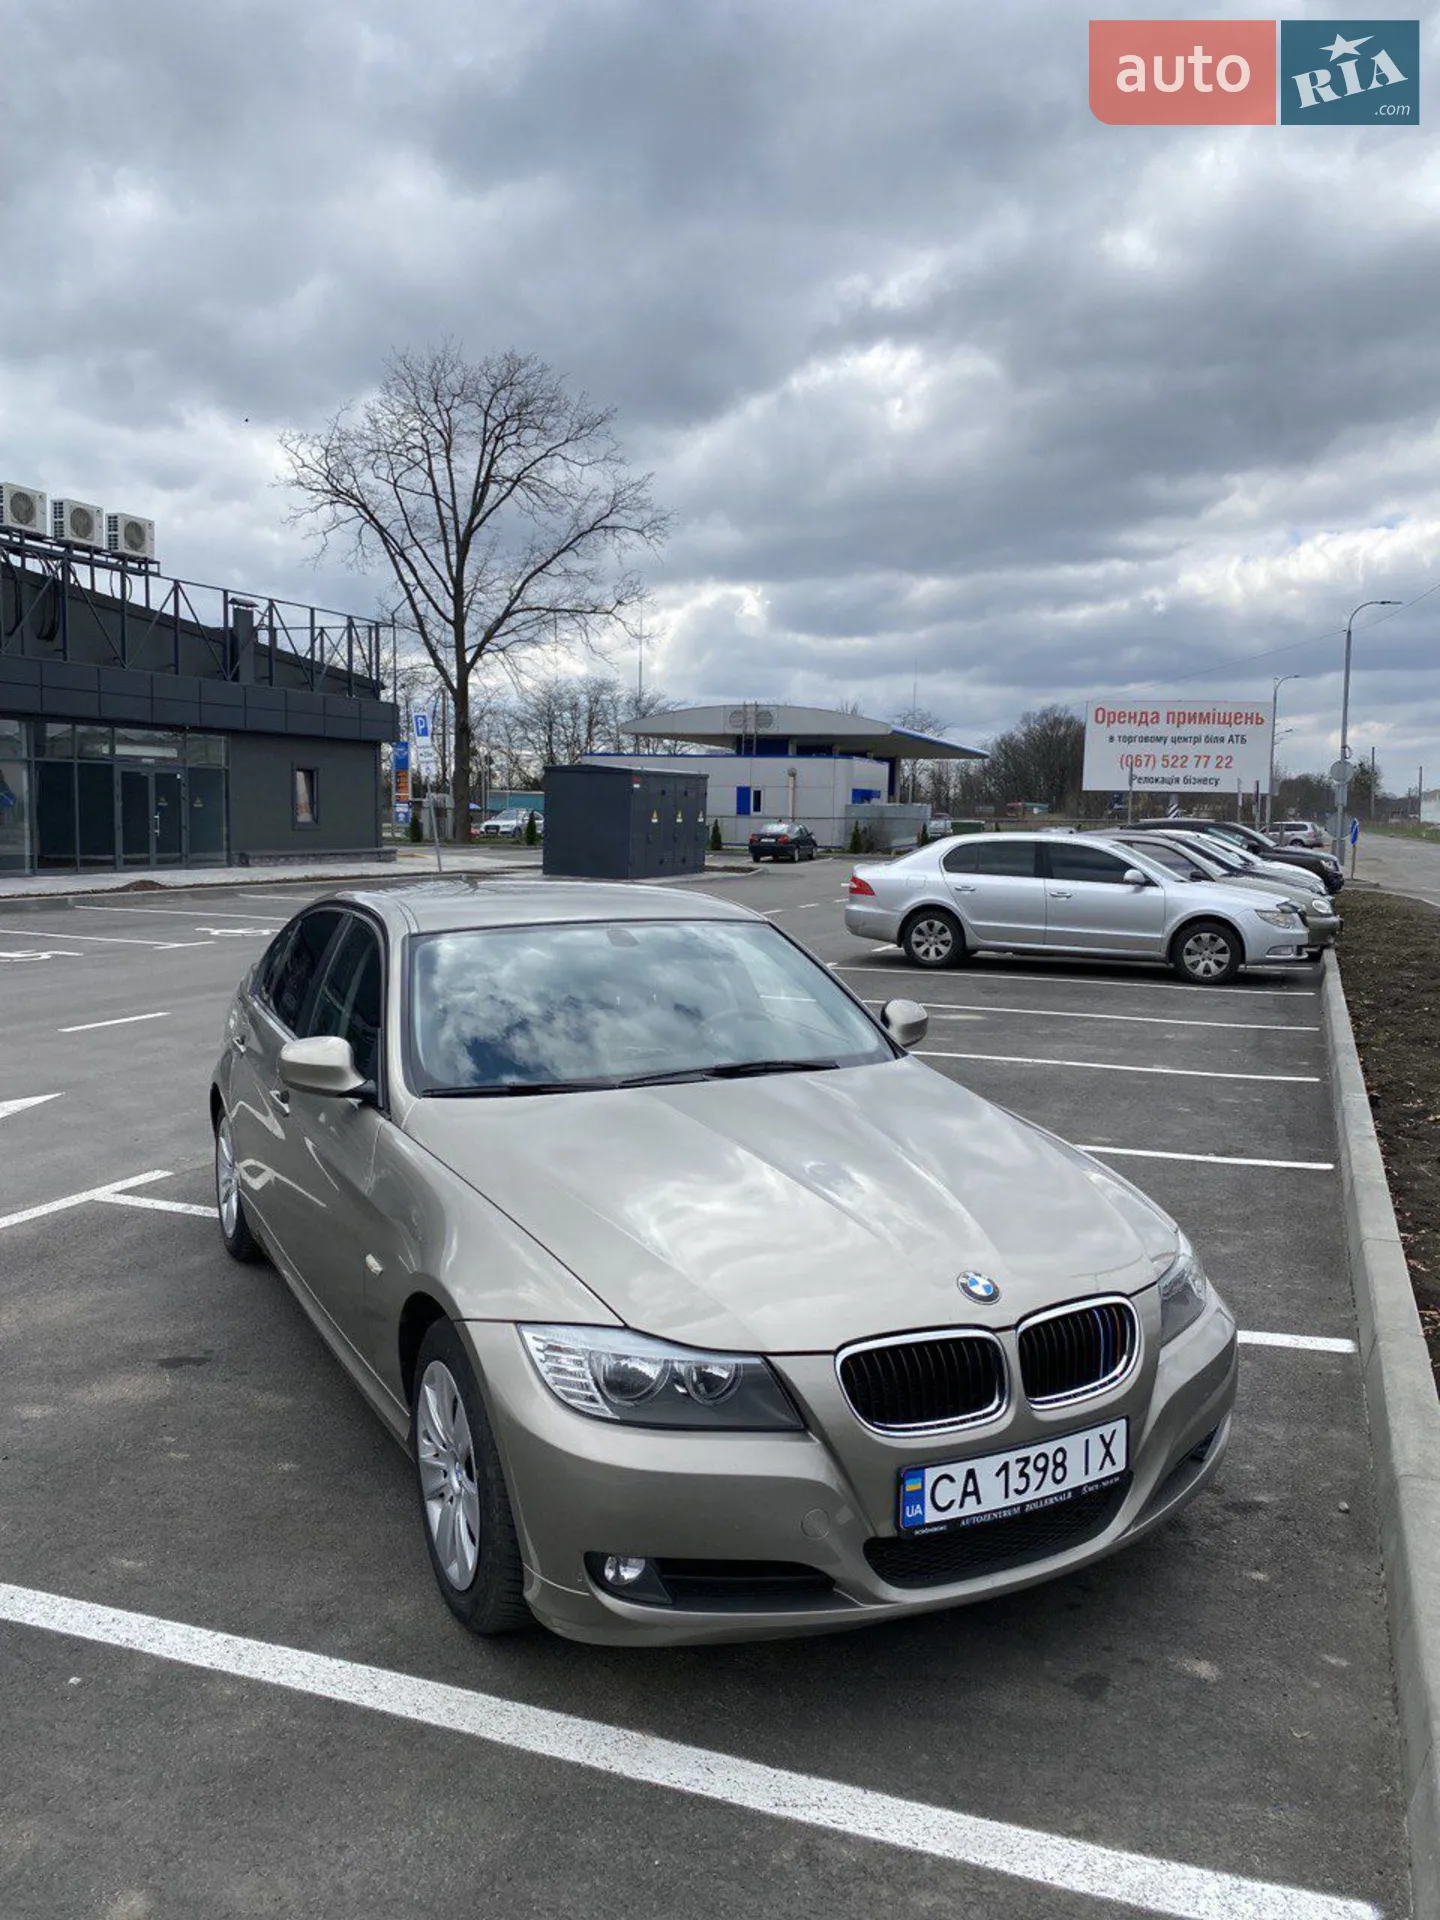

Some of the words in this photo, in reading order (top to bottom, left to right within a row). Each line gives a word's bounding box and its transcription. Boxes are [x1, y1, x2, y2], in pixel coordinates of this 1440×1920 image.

[1094, 707, 1160, 727] Оренда
[1166, 708, 1265, 728] приміщень
[1108, 735, 1114, 743] в
[1117, 735, 1168, 745] торговому
[1171, 734, 1202, 745] центрі
[1204, 734, 1225, 744] біля
[1227, 734, 1247, 745] АТБ
[1119, 754, 1157, 770] (067)
[1161, 754, 1188, 769] 522
[1194, 755, 1211, 768] 77
[1214, 755, 1234, 769] 22
[1131, 775, 1180, 787] Релокація
[1182, 775, 1221, 787] бізнесу
[930, 1468, 982, 1512] CA
[995, 1447, 1068, 1500] 1398
[1084, 1429, 1117, 1476] IX
[905, 1505, 923, 1518] UA
